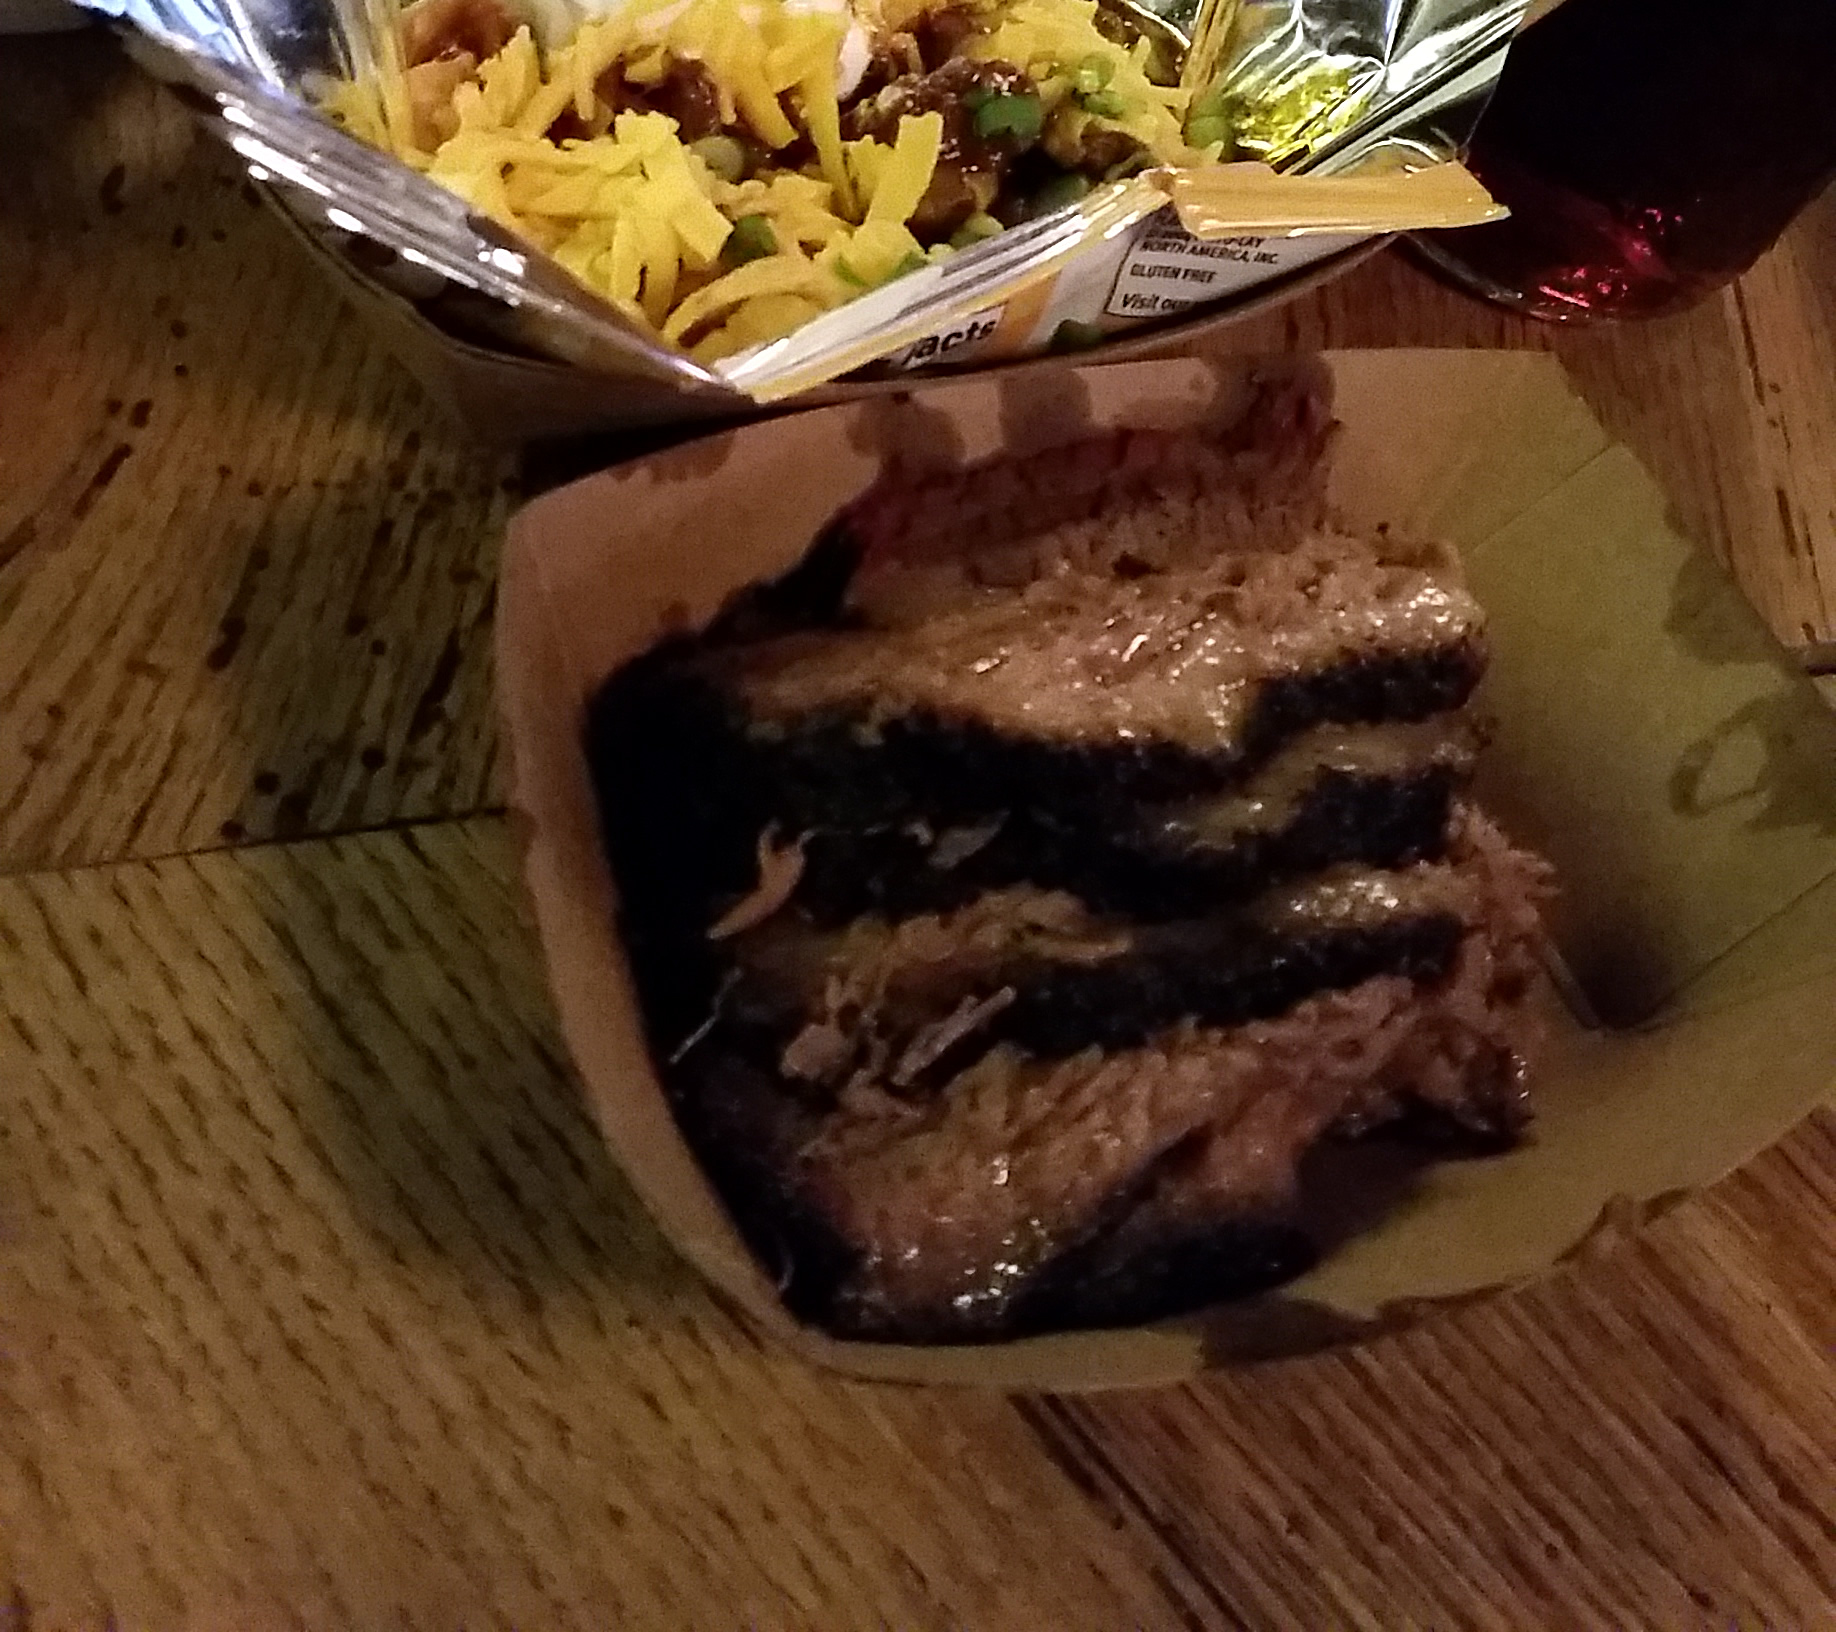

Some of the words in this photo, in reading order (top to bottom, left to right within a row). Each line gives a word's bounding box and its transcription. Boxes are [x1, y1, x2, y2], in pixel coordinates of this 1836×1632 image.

[1140, 240, 1186, 254] NORTH
[1130, 263, 1179, 280] GLUTEN
[1181, 268, 1218, 284] FREE
[1122, 293, 1160, 310] Visit
